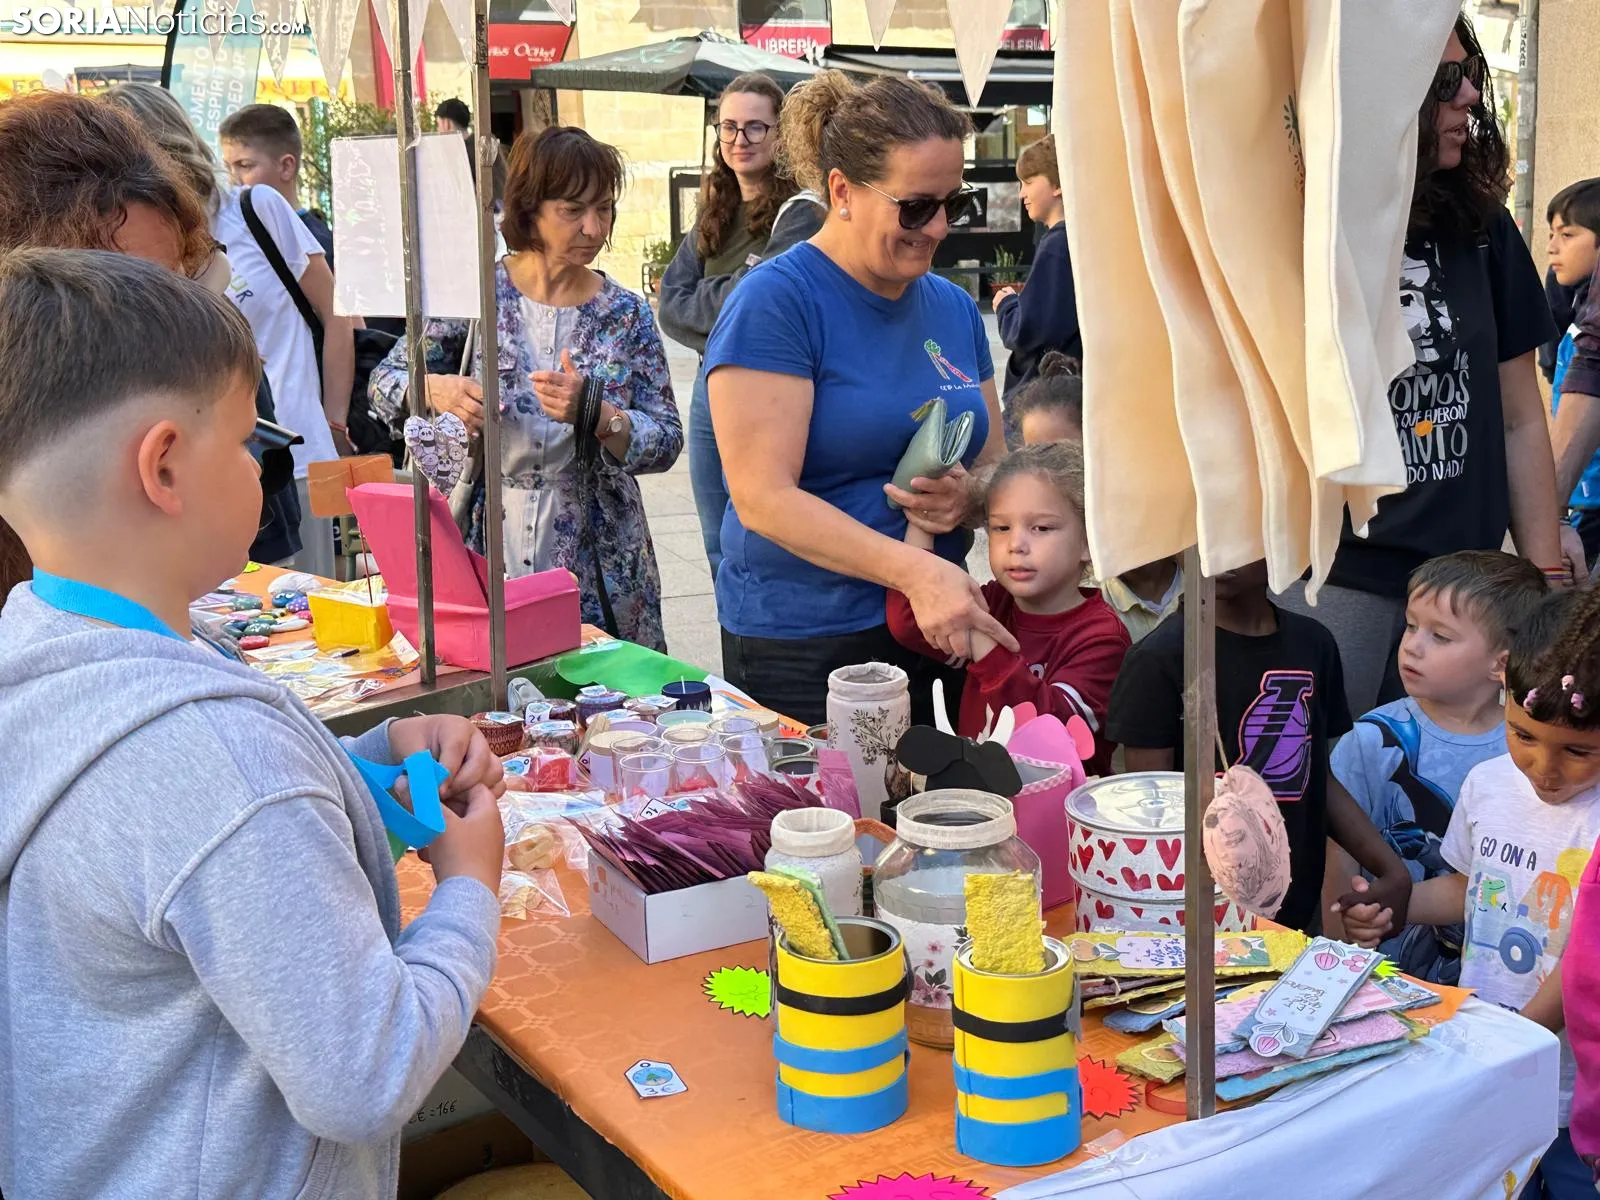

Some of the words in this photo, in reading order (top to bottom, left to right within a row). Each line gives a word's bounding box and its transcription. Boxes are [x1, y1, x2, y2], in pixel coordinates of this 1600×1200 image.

[1391, 369, 1470, 412] OMOS
[1480, 836, 1497, 857] GO
[1500, 843, 1524, 867] ON
[1526, 851, 1537, 871] A
